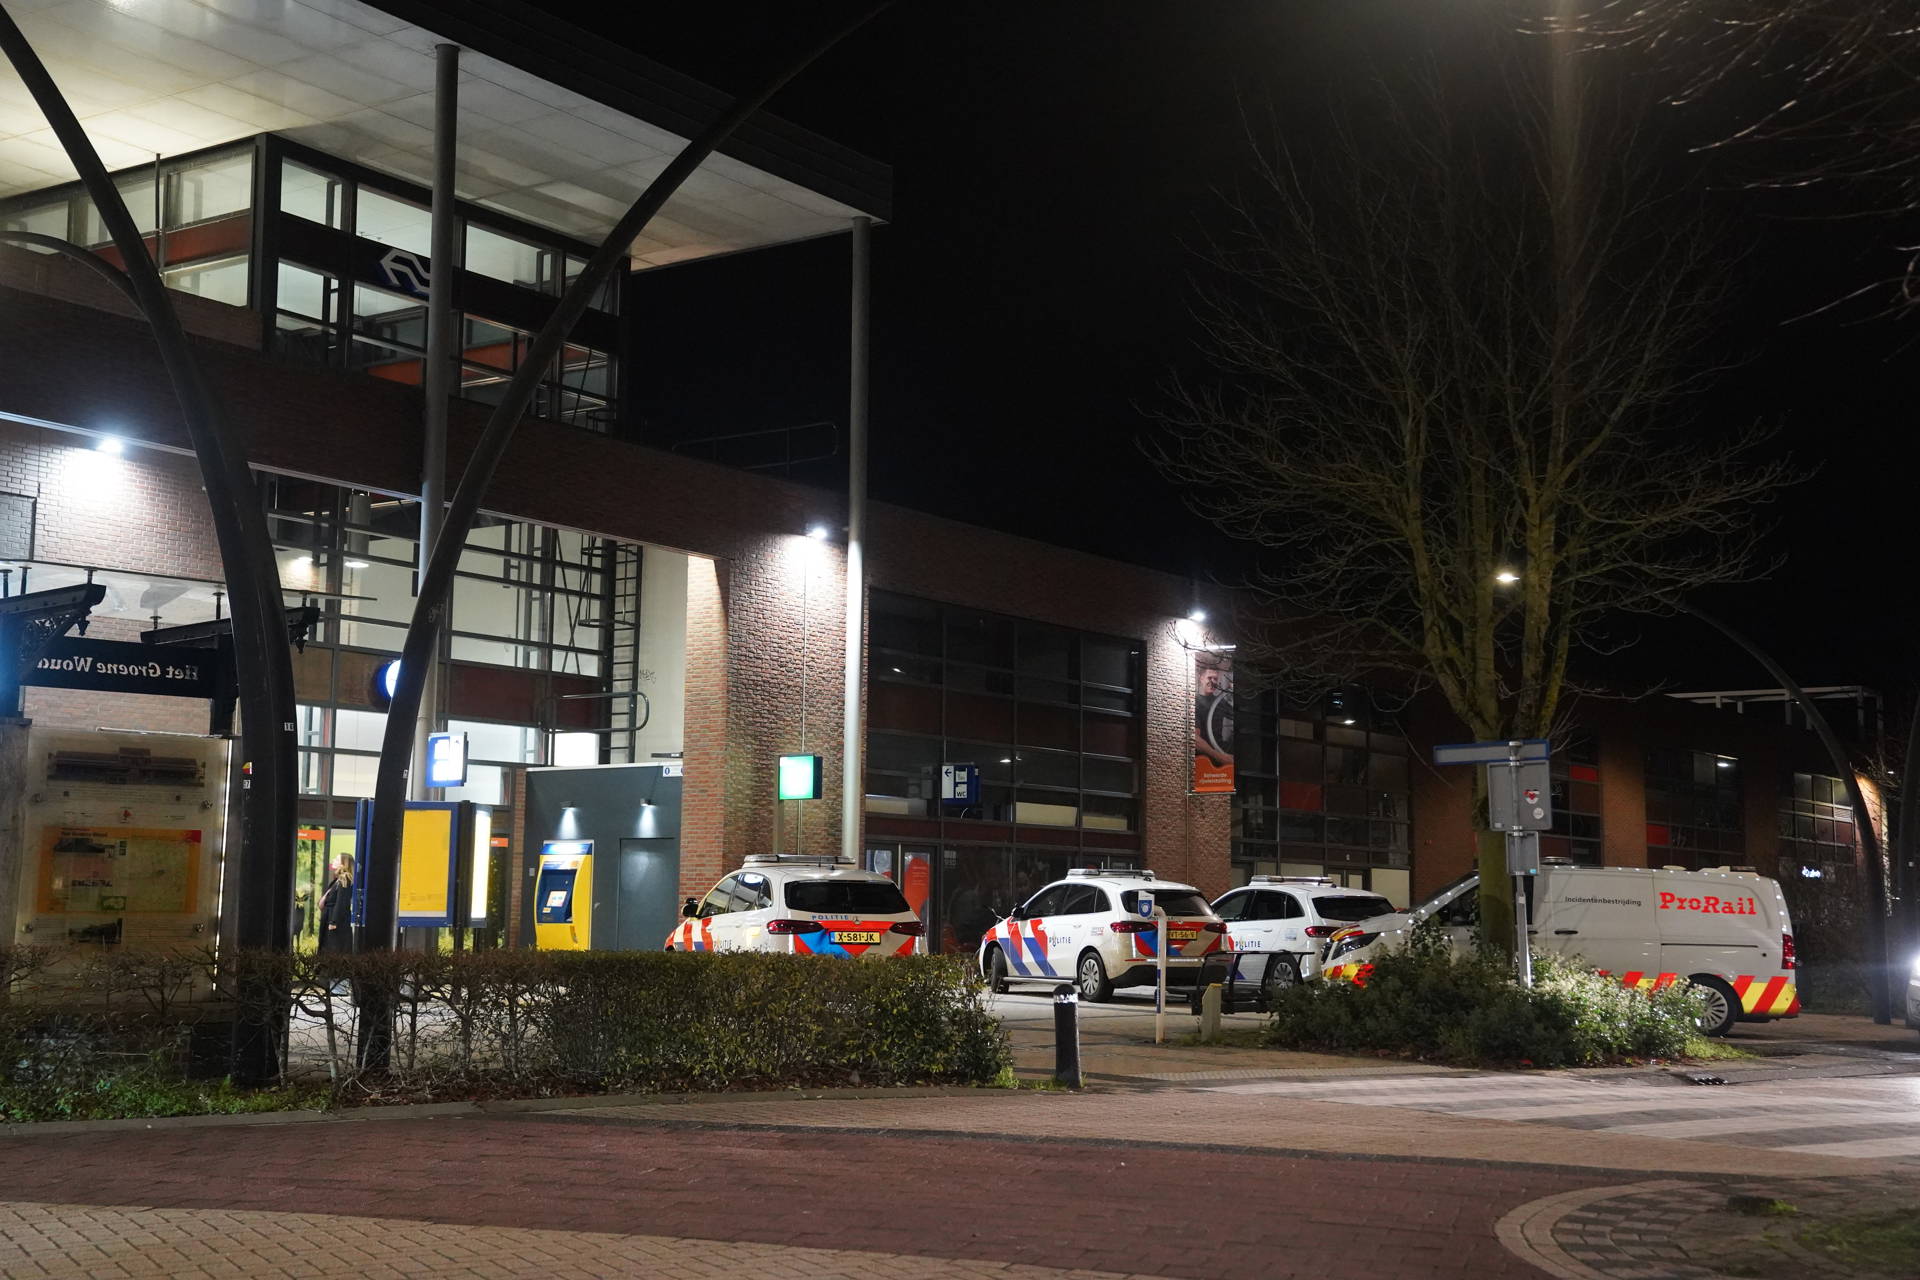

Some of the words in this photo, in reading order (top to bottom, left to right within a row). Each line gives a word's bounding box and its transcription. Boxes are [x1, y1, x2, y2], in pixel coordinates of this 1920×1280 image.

[1565, 895, 1642, 907] Incidentenbestrijding
[1658, 891, 1757, 915] ProRail
[838, 933, 875, 942] X-581-JK
[1049, 936, 1071, 946] POLITIE
[1235, 940, 1262, 949] POLITIE
